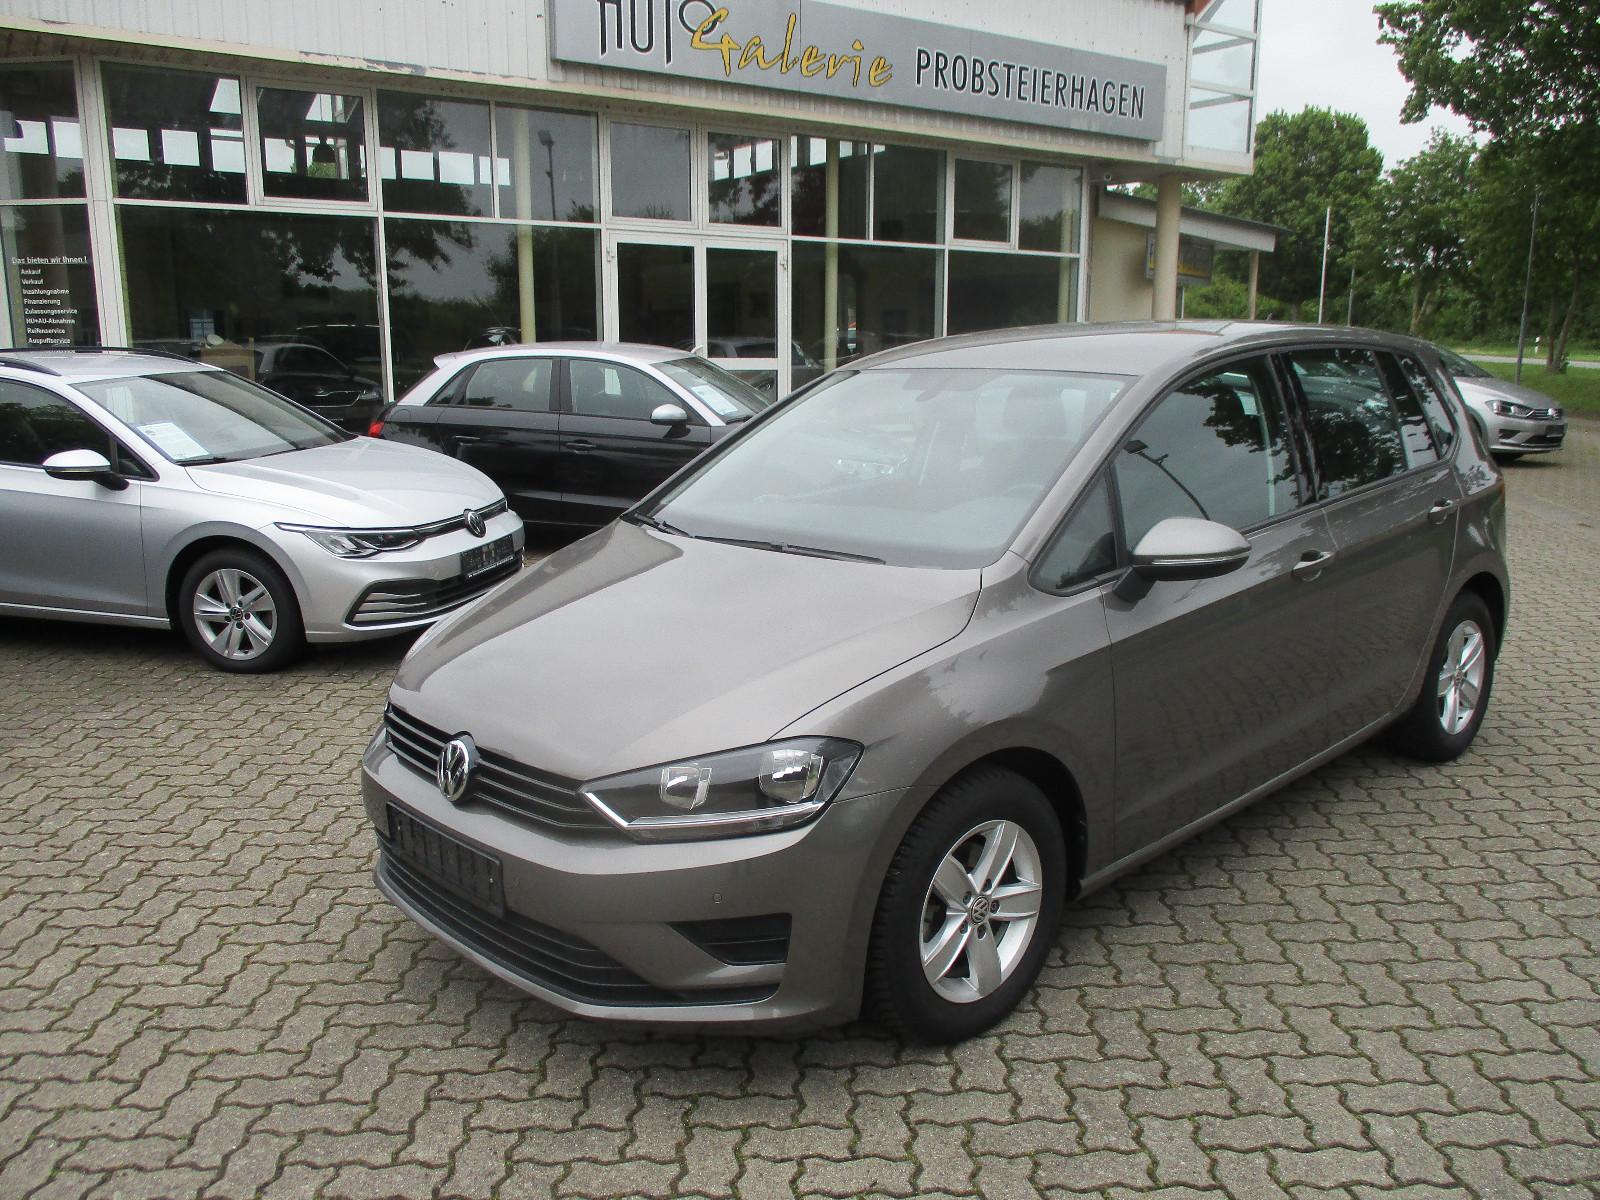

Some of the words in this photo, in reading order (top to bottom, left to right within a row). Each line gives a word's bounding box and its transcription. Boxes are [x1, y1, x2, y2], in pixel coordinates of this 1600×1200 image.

[690, 7, 894, 88] Galerie
[916, 48, 1145, 119] PROBSTEIERHAGEN
[27, 256, 49, 264] bieten
[50, 256, 62, 264] wir
[22, 288, 70, 296] Inzahlungnahme
[24, 298, 61, 306] Finanzierung
[24, 308, 78, 316] Zulassungsservice
[28, 337, 71, 345] Auspuffservice
